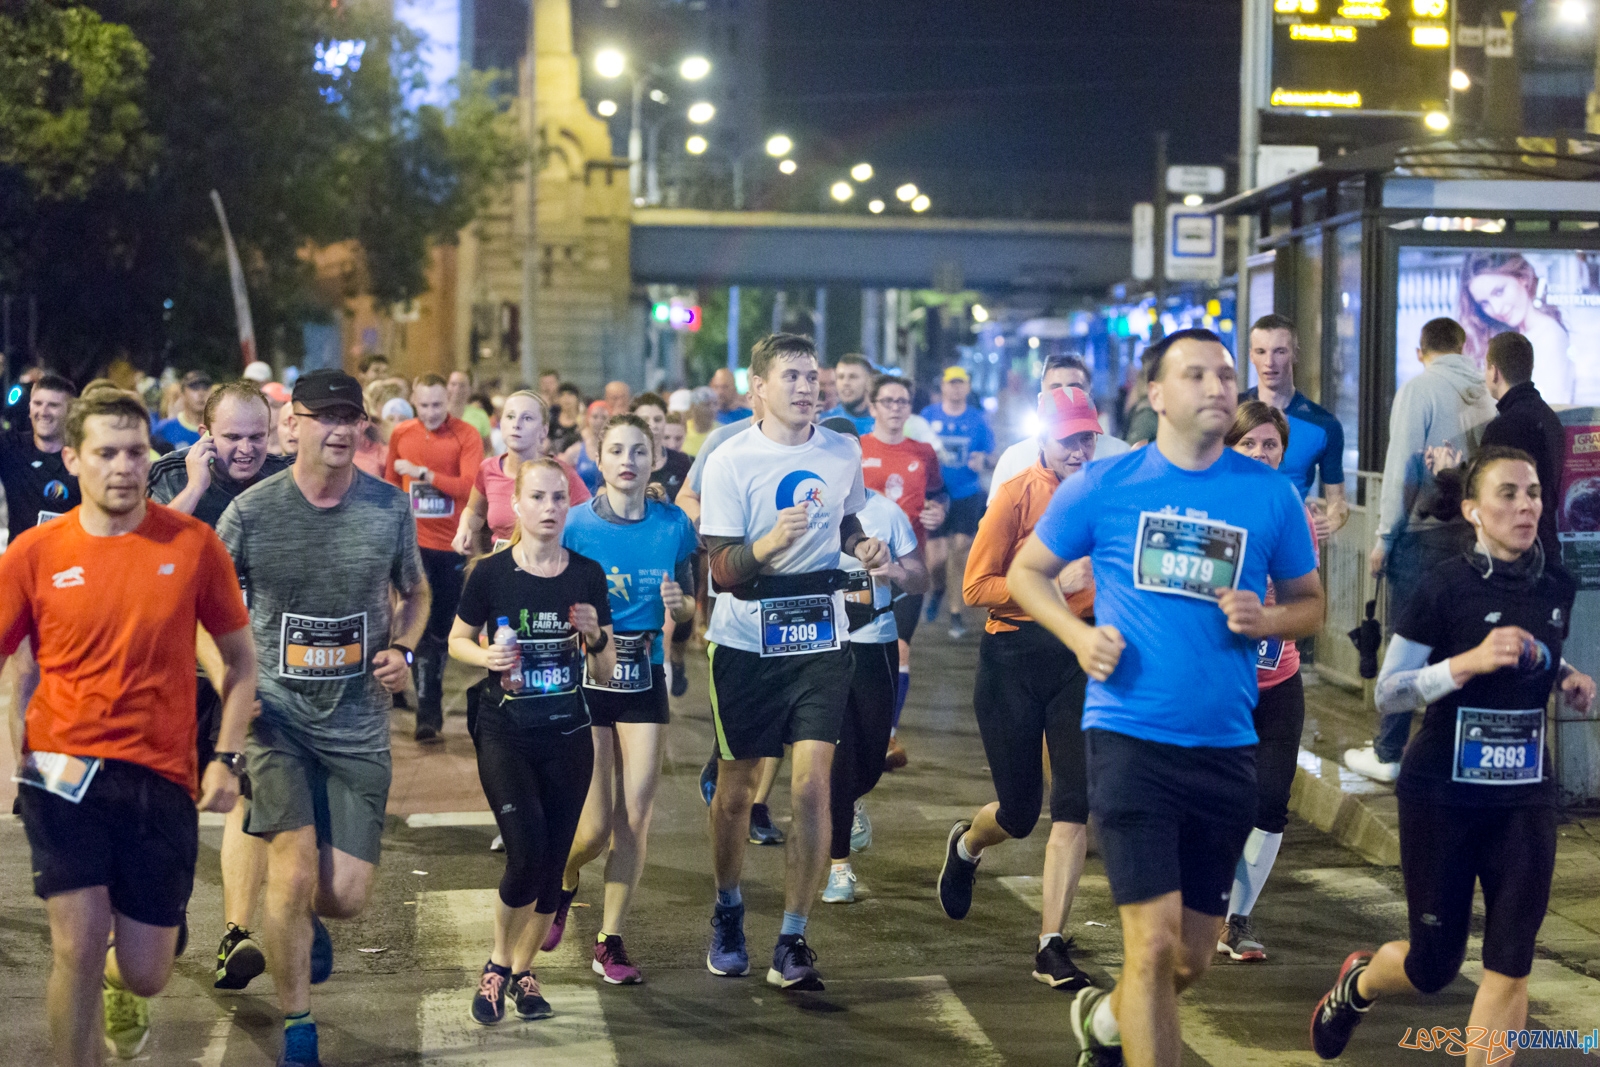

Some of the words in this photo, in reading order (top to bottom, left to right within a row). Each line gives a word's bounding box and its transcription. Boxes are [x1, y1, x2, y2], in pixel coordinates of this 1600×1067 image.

[1577, 433, 1600, 445] GRA
[1160, 552, 1215, 583] 9379
[532, 620, 552, 629] FAIR
[538, 612, 558, 621] BIEG
[779, 623, 818, 643] 7309
[303, 648, 346, 666] 4812
[1257, 640, 1268, 656] 3
[523, 666, 571, 688] 10683
[1479, 745, 1526, 768] 2693
